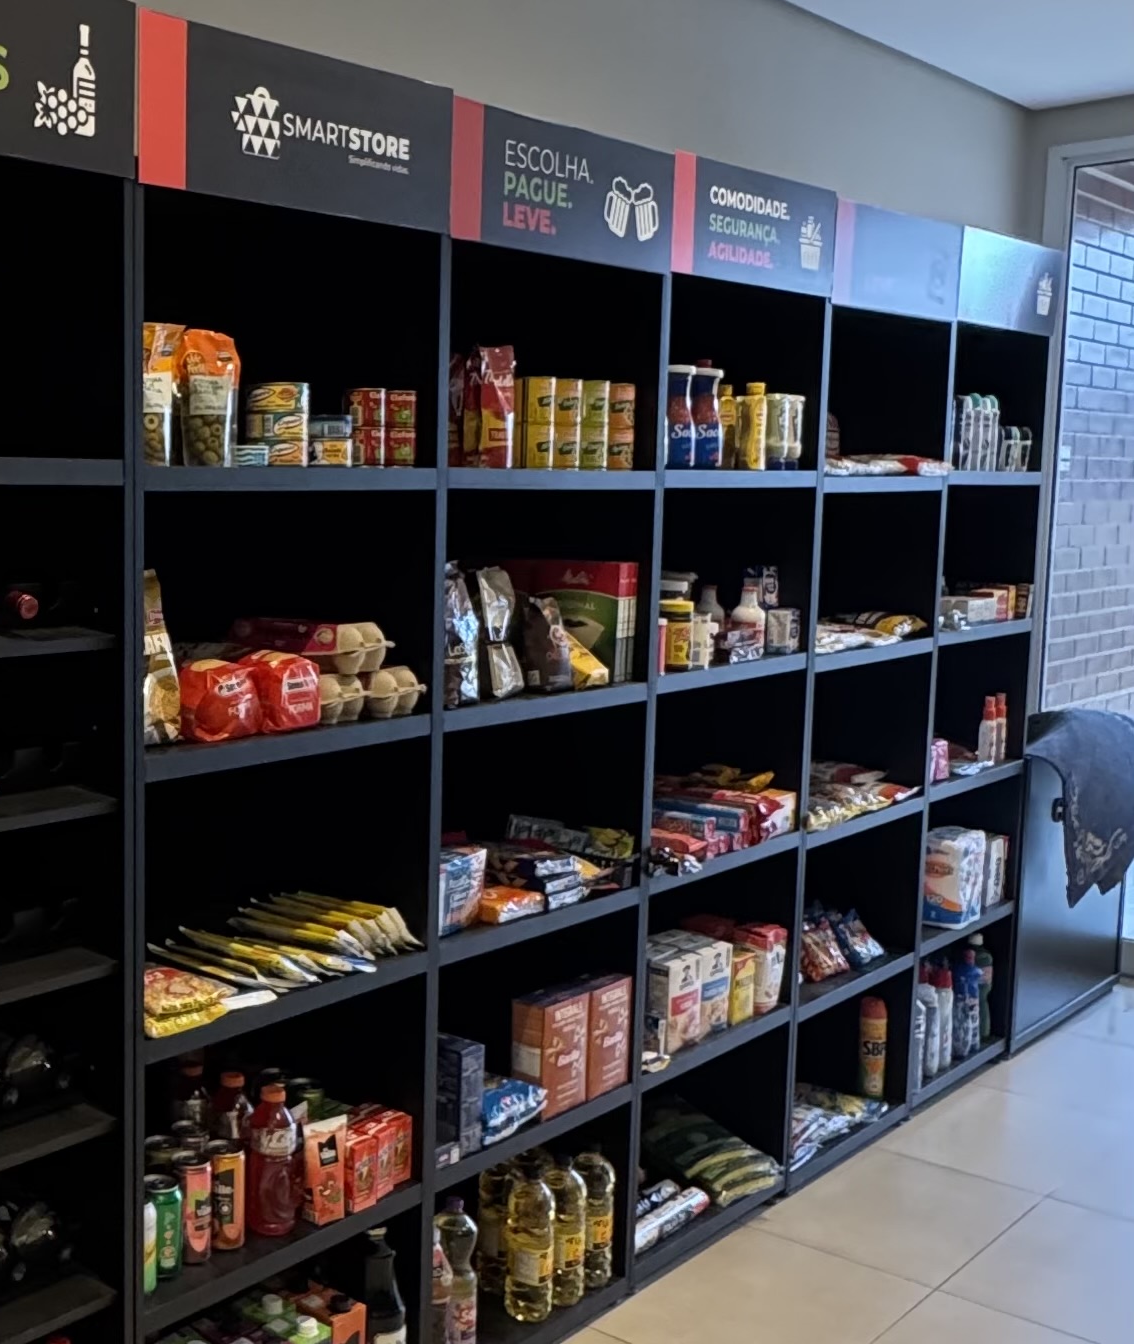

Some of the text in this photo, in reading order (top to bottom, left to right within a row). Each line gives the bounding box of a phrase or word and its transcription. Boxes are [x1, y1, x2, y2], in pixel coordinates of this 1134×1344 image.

[282, 112, 411, 161] SMARTSTORE
[504, 138, 595, 185] ESCOLHA.
[503, 171, 573, 209] PAGUE.
[709, 185, 791, 221] COMODIDADE.
[502, 201, 557, 235] LEVE.
[708, 213, 781, 247] SEGURANÇA.
[707, 241, 775, 270] AGILIDADE.
